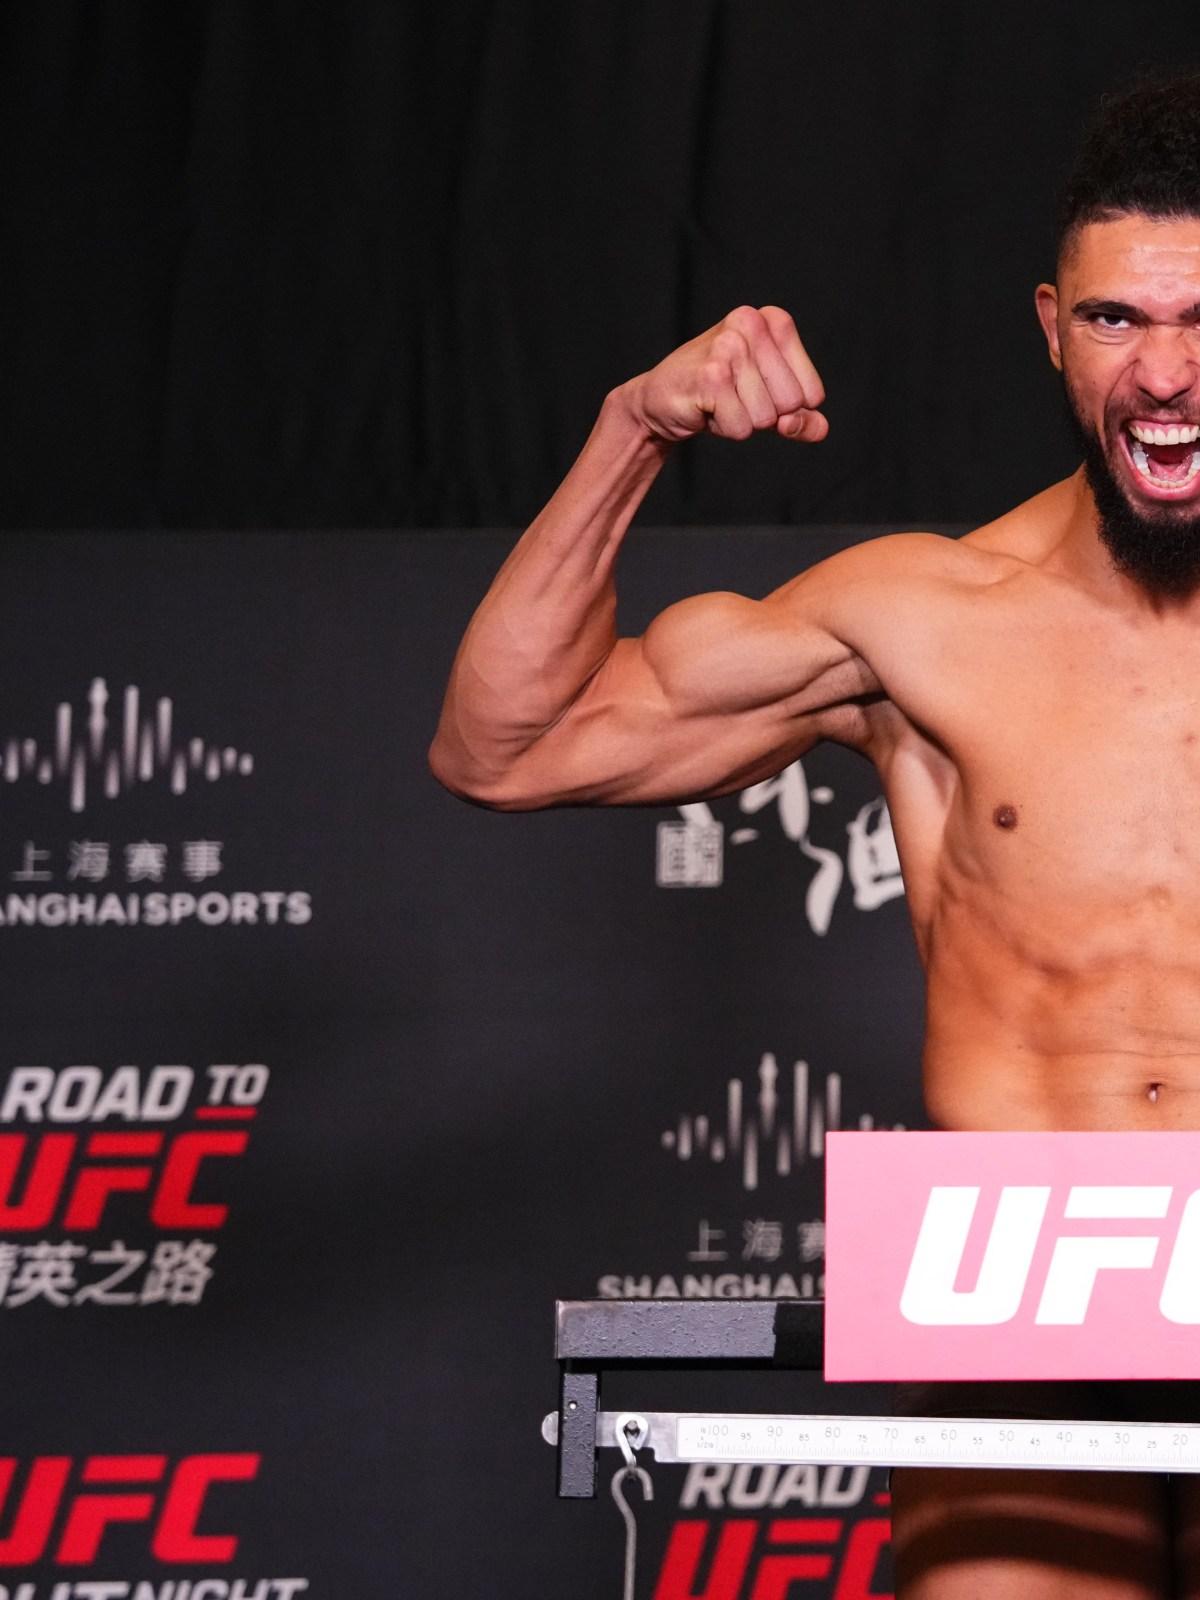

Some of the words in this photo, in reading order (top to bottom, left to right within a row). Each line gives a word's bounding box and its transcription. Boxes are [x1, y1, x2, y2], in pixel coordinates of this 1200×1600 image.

[0, 891, 312, 926] NGHAISPORTS
[1, 1066, 194, 1122] ROAD
[207, 1064, 269, 1105] TO
[0, 1240, 217, 1308] 英之路
[767, 1425, 783, 1437] 90
[884, 1427, 899, 1440] 70
[940, 1429, 957, 1441] 60
[999, 1430, 1015, 1442] 50
[1056, 1431, 1073, 1443] 40
[1114, 1432, 1130, 1445] 30
[1172, 1433, 1188, 1446] 20
[680, 1463, 871, 1509] ROAD
